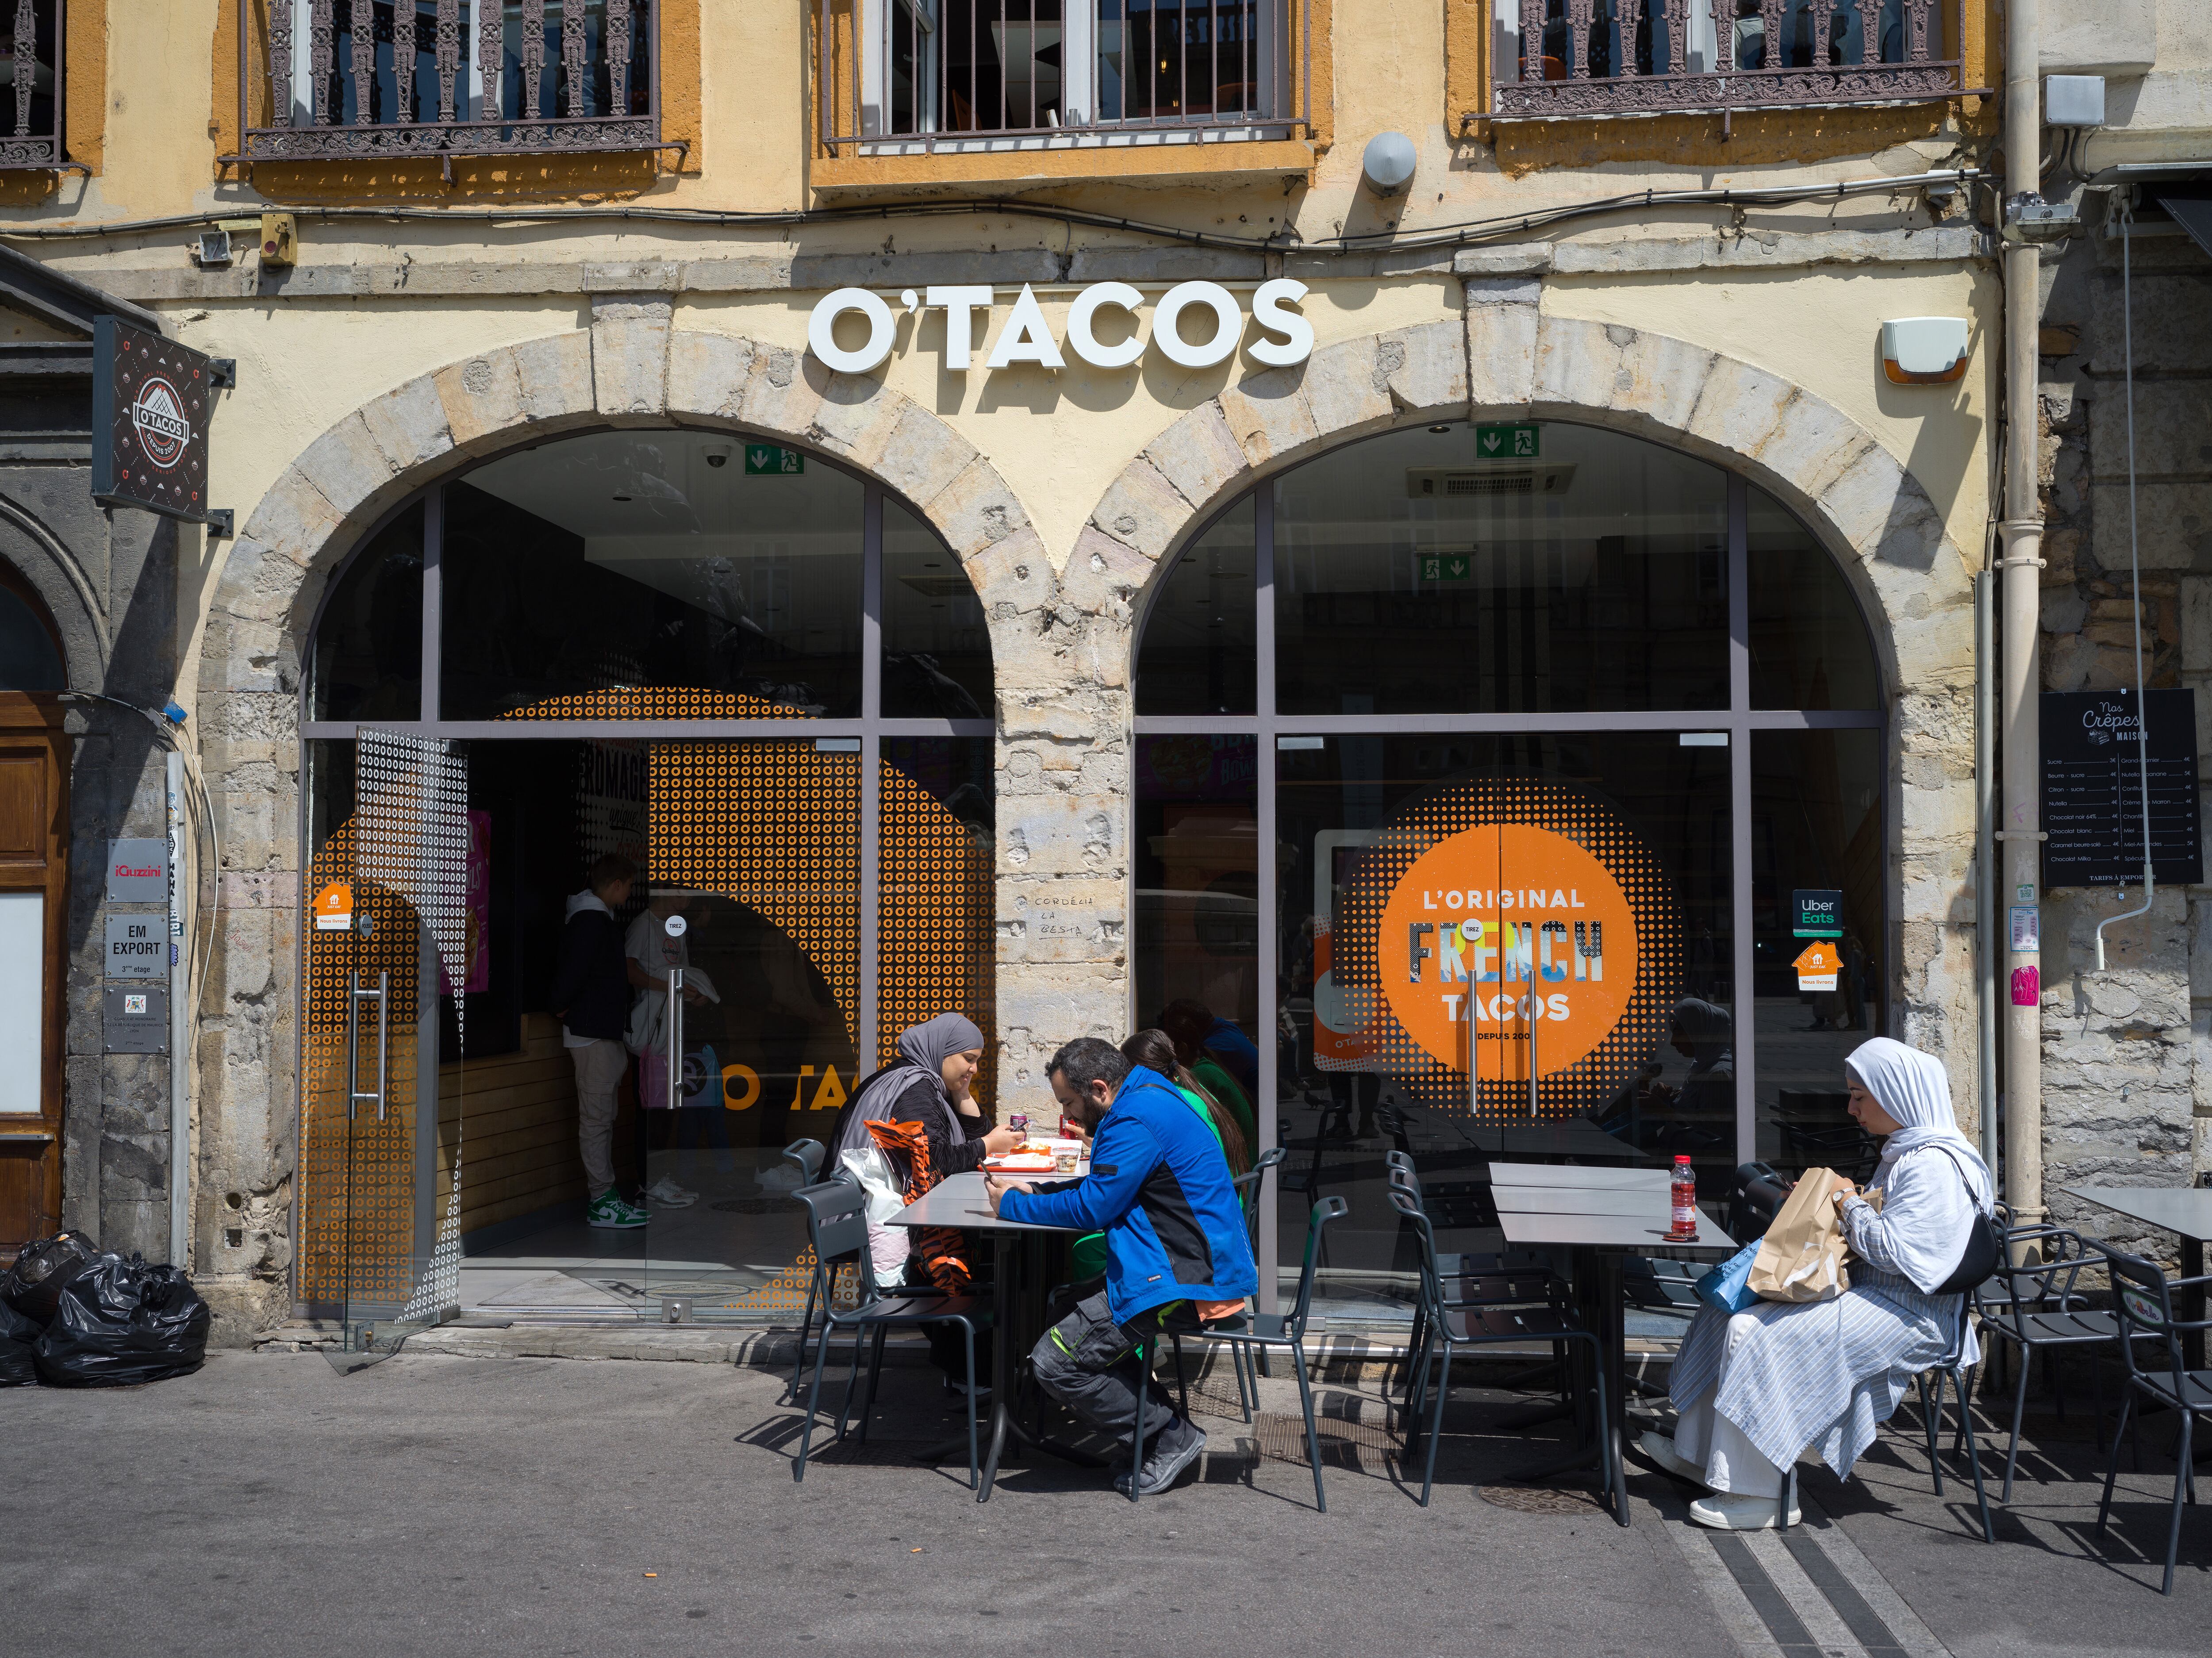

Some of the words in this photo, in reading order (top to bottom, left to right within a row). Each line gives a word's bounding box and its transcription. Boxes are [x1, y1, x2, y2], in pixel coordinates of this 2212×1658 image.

[808, 278, 1314, 375] O'TACOS
[134, 371, 154, 400] ORIGINAL
[157, 371, 177, 388] FRENCH
[141, 410, 182, 436] O'TACOS
[147, 433, 164, 454] DEPUIS
[164, 441, 176, 454] 2007
[152, 465, 176, 475] SERIOUS
[178, 448, 188, 467] FOOD
[2099, 702, 2124, 712] Nos
[2082, 710, 2140, 732] Crêpes
[115, 865, 161, 877] iGuzzini
[1424, 889, 1585, 909] L'ORIGINAL
[1802, 900, 1834, 911] Uber
[1802, 912, 1834, 923] Eats
[129, 925, 146, 937] EM
[113, 942, 161, 955] EXPORT
[1409, 920, 1603, 983] FRENCH
[1442, 994, 1570, 1022] TACOS
